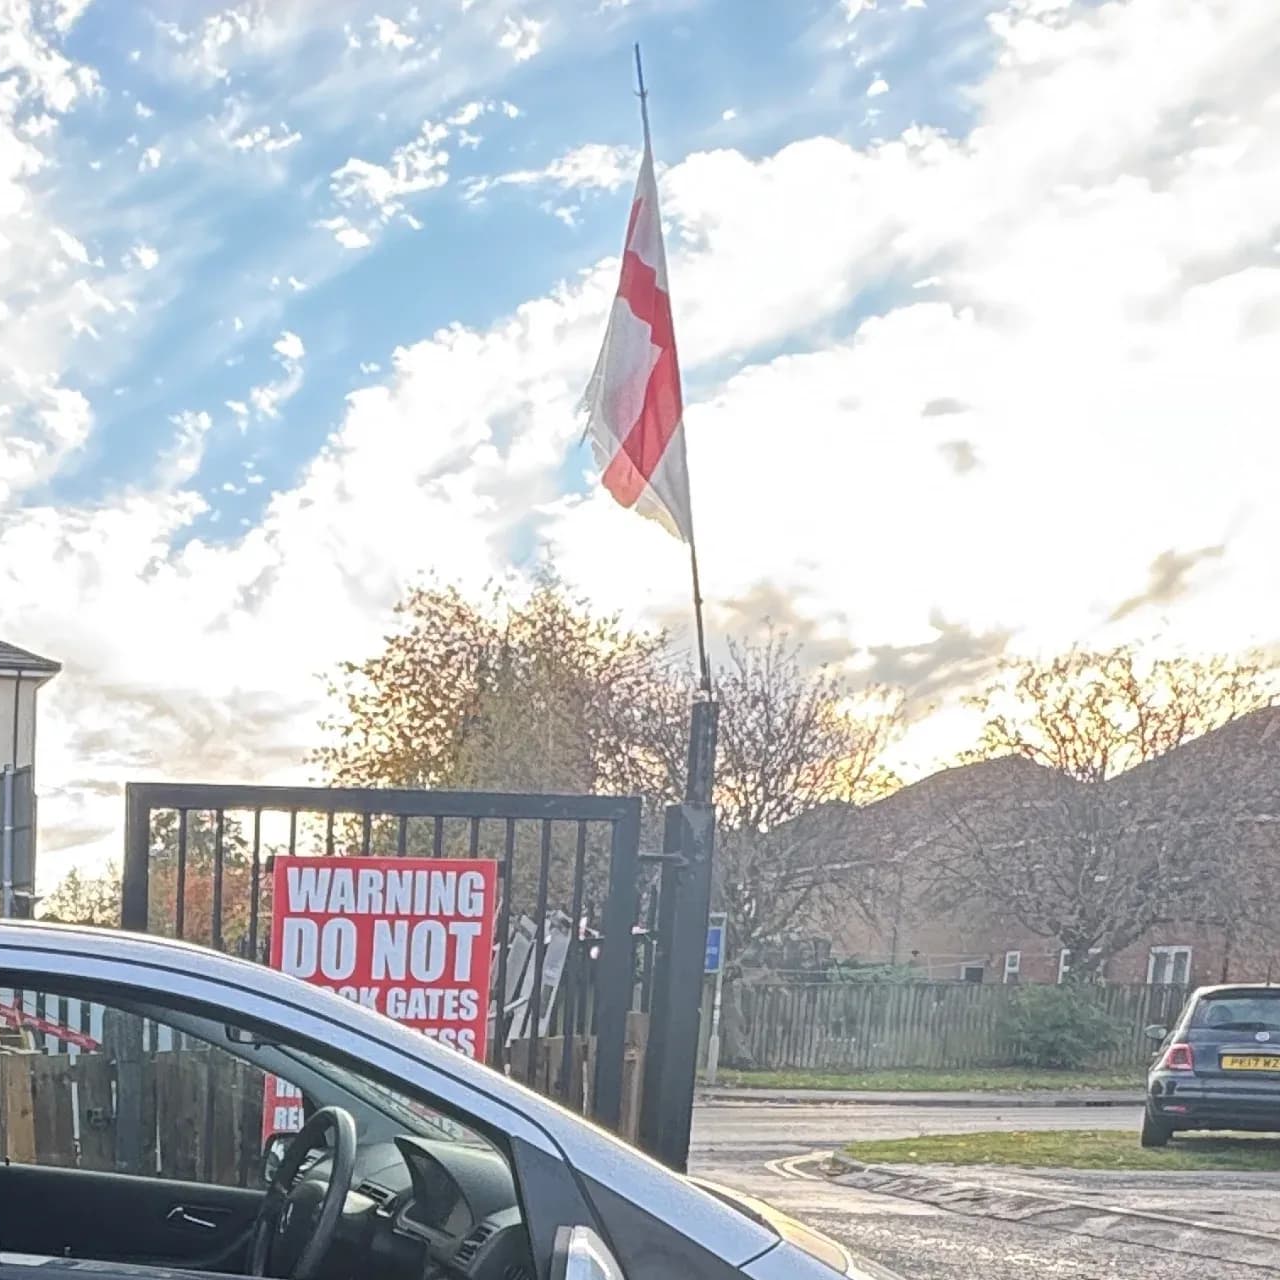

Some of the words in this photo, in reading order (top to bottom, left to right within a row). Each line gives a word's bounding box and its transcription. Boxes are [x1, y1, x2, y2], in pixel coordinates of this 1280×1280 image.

[286, 867, 485, 918] WARNING
[282, 918, 357, 980] DO
[371, 920, 482, 982] NOT
[386, 987, 479, 1021] GATES
